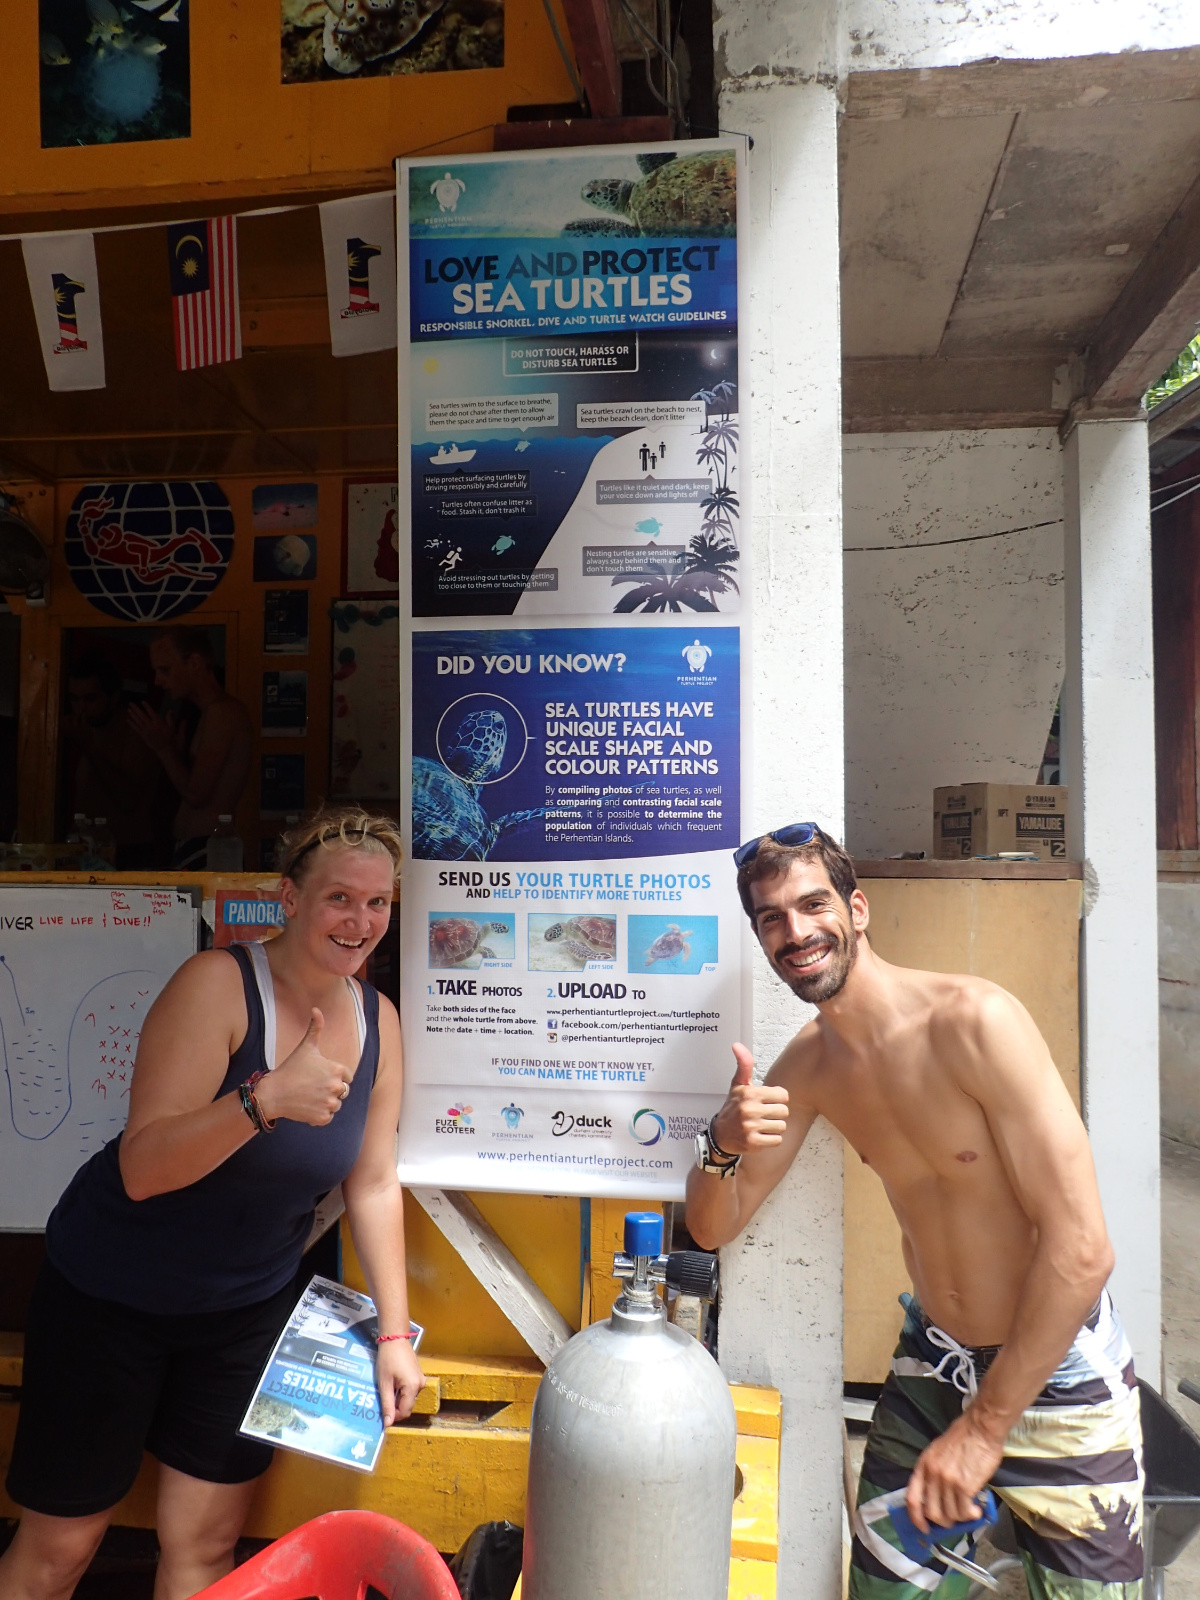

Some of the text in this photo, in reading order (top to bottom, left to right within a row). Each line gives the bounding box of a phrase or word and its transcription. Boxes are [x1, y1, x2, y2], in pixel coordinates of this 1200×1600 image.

[425, 245, 720, 284] LOVE AND PROTECT
[453, 274, 692, 314] SEA TURTLES
[420, 320, 483, 333] RESPONSIBLE
[538, 316, 560, 327] DIVE
[563, 315, 587, 325] AND
[590, 314, 627, 324] TURTLE
[629, 312, 665, 323] WATCH
[668, 310, 726, 322] GUIDELINES
[511, 346, 629, 359] DO NOT TOUCH, HARASS OR
[522, 356, 617, 369] DISTURB SEA TURTLES
[437, 653, 626, 674] DID YOU KNOW?
[545, 702, 714, 718] SEA TURTLES HAVE
[546, 721, 684, 737] UNIQUE FACIAL
[545, 740, 712, 756] SCALE SHAPE AND
[545, 759, 718, 775] COLOUR PATTERNS
[545, 786, 555, 795] By
[558, 786, 600, 795] compiling
[602, 786, 632, 795] photos
[636, 786, 644, 794] of
[663, 786, 690, 795] turtles,
[706, 786, 722, 794] well
[557, 798, 601, 807] comparing
[623, 798, 671, 807] contrasting
[674, 798, 697, 806] facial
[701, 798, 722, 806] scale
[545, 811, 582, 820] patterns,
[608, 810, 640, 819] possible
[658, 810, 703, 819] determine
[707, 810, 722, 819] the
[545, 822, 591, 831] population
[610, 822, 652, 831] individuals
[658, 822, 681, 831] which
[687, 822, 722, 832] frequent
[1019, 817, 1062, 829] YAMALUBE
[561, 834, 602, 842] Perhentian
[606, 834, 633, 842] Islands.
[1053, 842, 1064, 855] 2
[439, 872, 711, 888] SEND US YOUR TURTLE PHOTOS
[466, 888, 682, 900] AND HELP TO IDENTIFY MORE TURTLES
[427, 980, 522, 996] 1. TAKE PHOTOS
[547, 982, 646, 999] 2. UPLOAD TO
[562, 1020, 718, 1033] facebook.com/perhentianturtleproject
[562, 1034, 664, 1045] @perhentianturtleproject
[521, 1059, 541, 1067] FIND
[607, 1062, 634, 1070] KNOW
[637, 1062, 654, 1071] YET,
[498, 1067, 516, 1075] YOU
[538, 1069, 572, 1080] NAME
[576, 1070, 597, 1080] THE
[602, 1070, 645, 1081] TURTLE
[576, 1115, 612, 1127] duck
[669, 1116, 709, 1125] NATIONAL
[669, 1124, 701, 1132] MARINE
[478, 1151, 672, 1168] www.perhentianturtleproject.com
[267, 1380, 321, 1404] PROTECT
[282, 1370, 376, 1408] SEA TURTLES
[322, 1400, 350, 1411] AND
